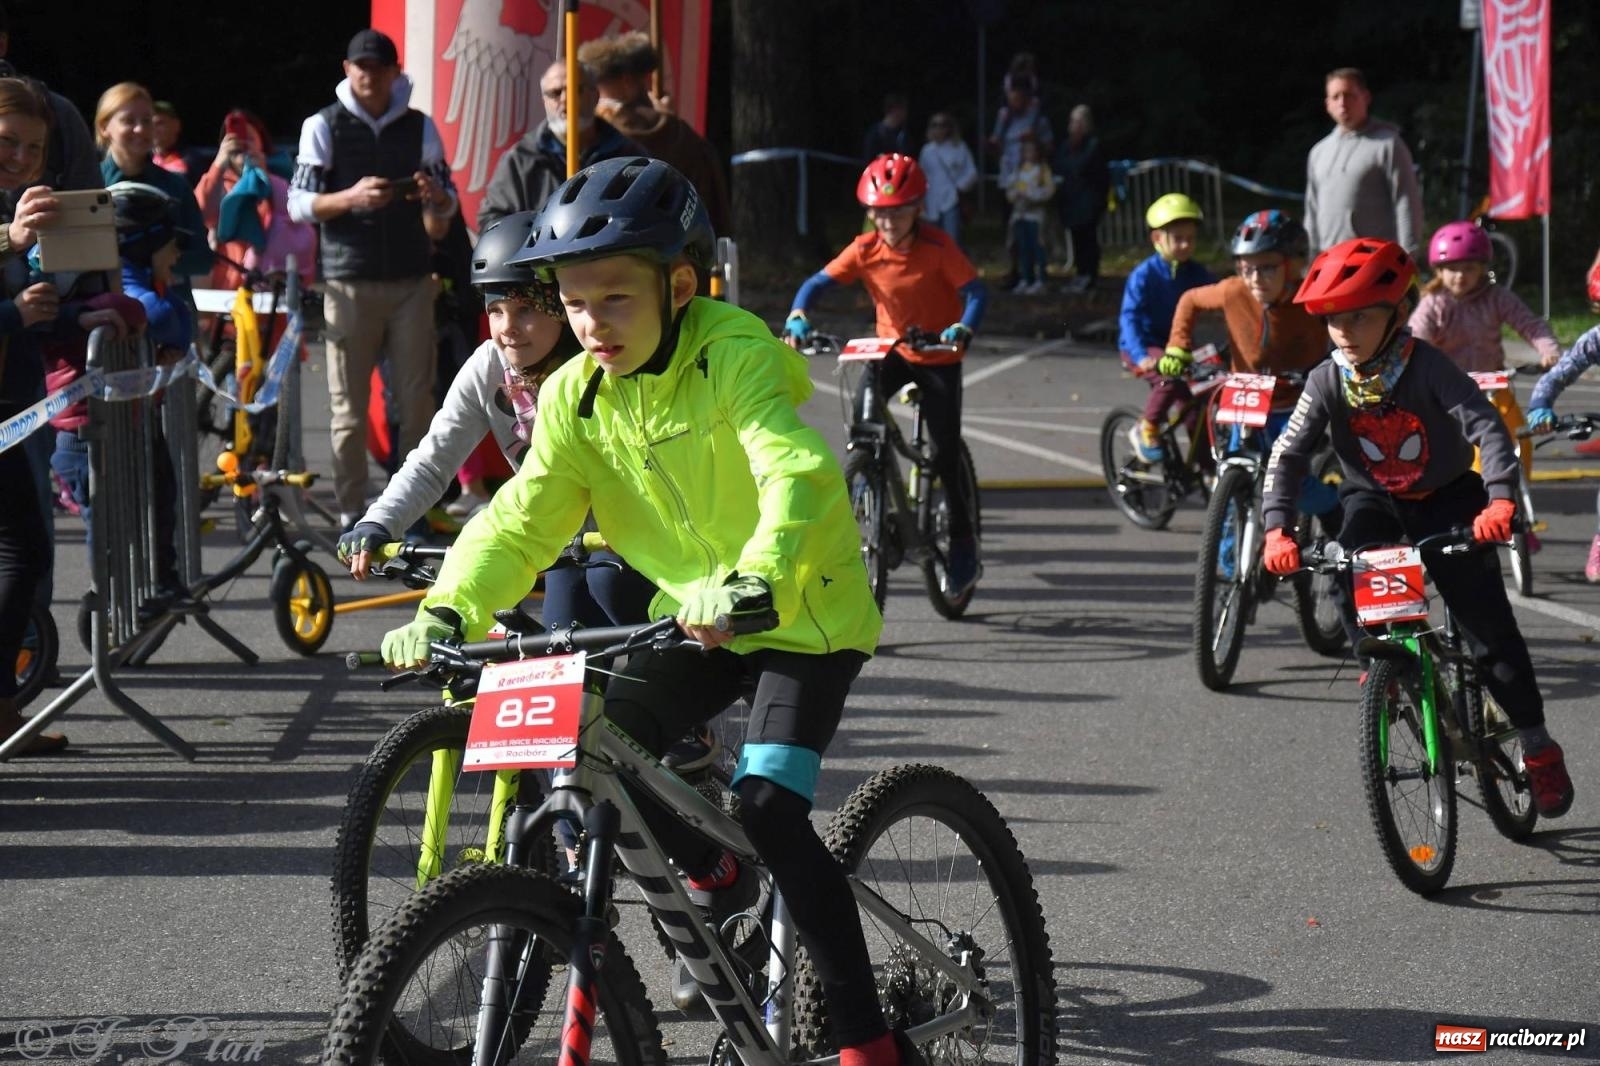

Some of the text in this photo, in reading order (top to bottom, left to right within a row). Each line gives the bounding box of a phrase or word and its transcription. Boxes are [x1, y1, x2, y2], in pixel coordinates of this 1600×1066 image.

[680, 180, 698, 232] BELL
[495, 695, 556, 728] 82
[505, 748, 547, 758] Racibórz
[605, 722, 662, 769] SCOTT
